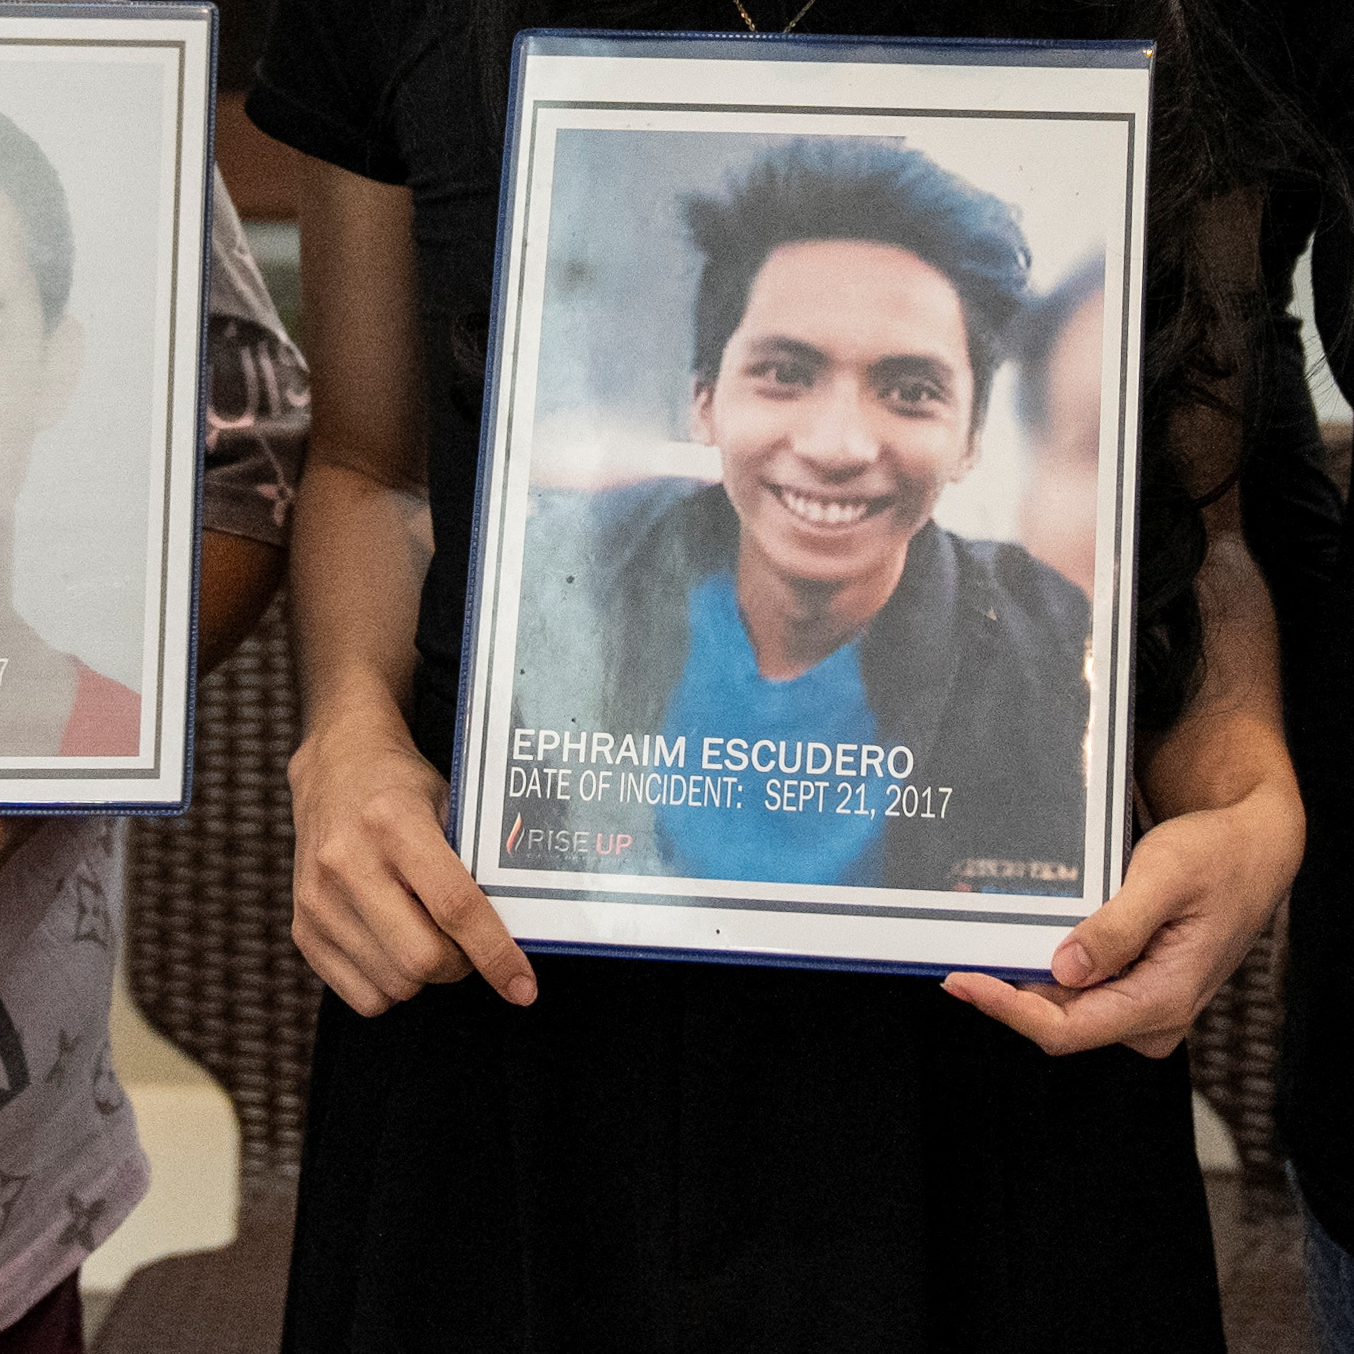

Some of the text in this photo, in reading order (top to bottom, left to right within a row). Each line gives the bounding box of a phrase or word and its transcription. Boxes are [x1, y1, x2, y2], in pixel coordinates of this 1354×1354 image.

[512, 728, 914, 779] EPHRAIM ESCUDERO
[509, 767, 952, 821] DATE OF INCIDENT: SEPT 21, 2017
[528, 829, 634, 855] RISE UP
